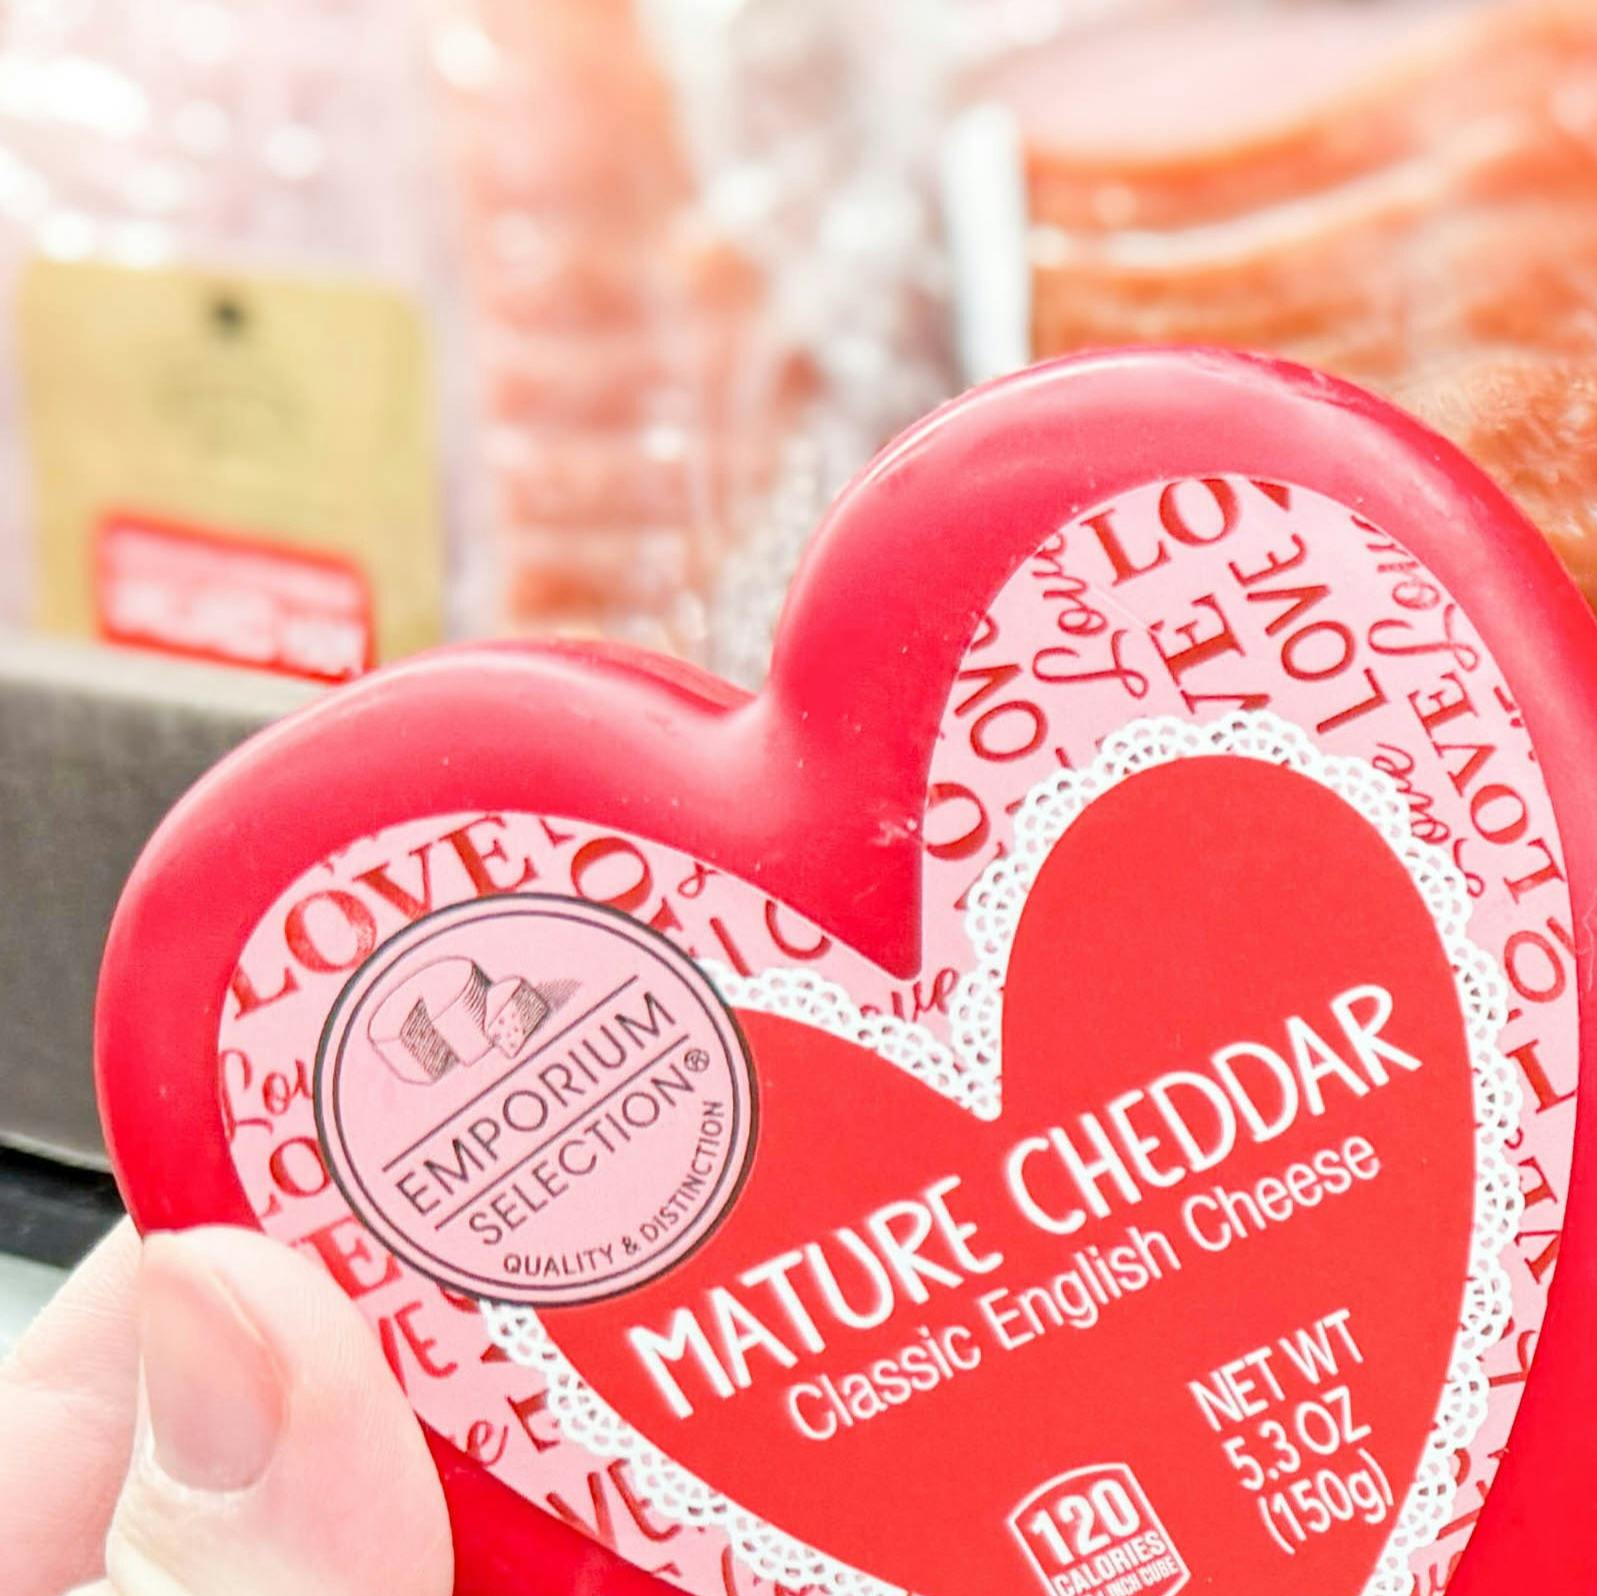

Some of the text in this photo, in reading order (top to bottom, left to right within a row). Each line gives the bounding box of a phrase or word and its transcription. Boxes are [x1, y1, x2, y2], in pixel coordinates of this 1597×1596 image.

[1225, 533, 1390, 736] LOVE
[1407, 669, 1567, 905] LOVE
[229, 814, 540, 1022] LOVE
[394, 990, 677, 1217] EMPORIUM
[502, 1100, 725, 1277] QUALITY & DISTINCTION
[625, 1174, 1006, 1419] MATURE
[1005, 984, 1423, 1237] CHEDDAR
[787, 1323, 982, 1443] Classic
[981, 1226, 1181, 1354] English
[1182, 1131, 1381, 1256] Cheese
[1188, 1307, 1365, 1432] NET WT
[1223, 1385, 1373, 1492] 5.3 OZ
[1030, 1479, 1141, 1567] 120
[1139, 1556, 1178, 1586] CUBE
[1257, 1448, 1395, 1556] (150g)
